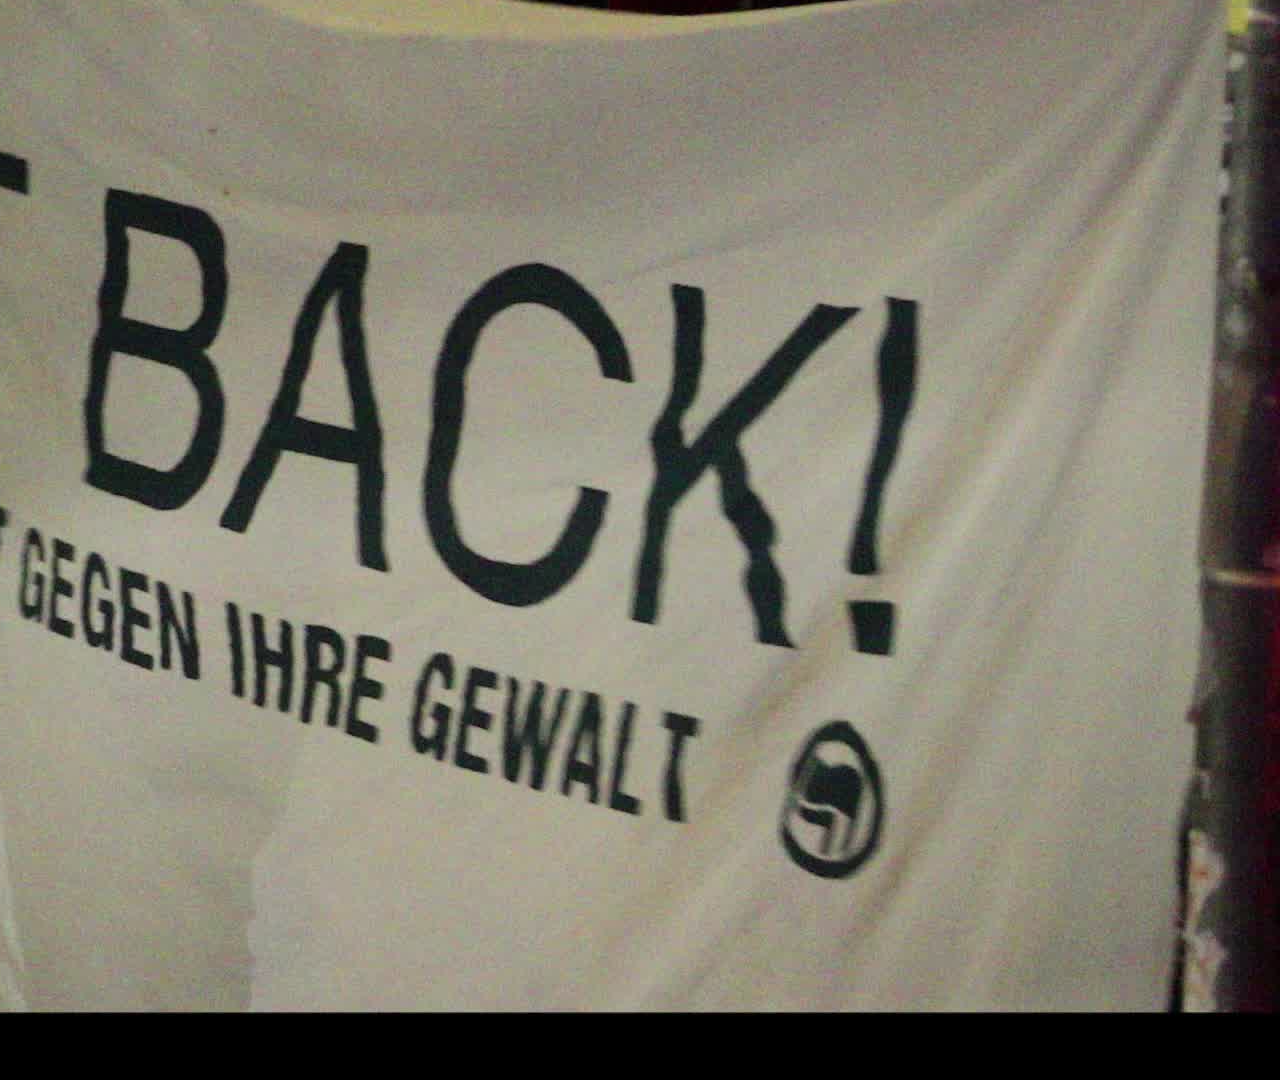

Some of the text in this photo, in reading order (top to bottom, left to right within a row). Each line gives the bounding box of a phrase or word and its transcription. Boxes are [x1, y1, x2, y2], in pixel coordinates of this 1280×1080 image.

[85, 188, 919, 657] BACK!
[18, 524, 200, 681] GEGEN
[226, 602, 392, 744] IHRE
[410, 651, 701, 824] GEWALT
